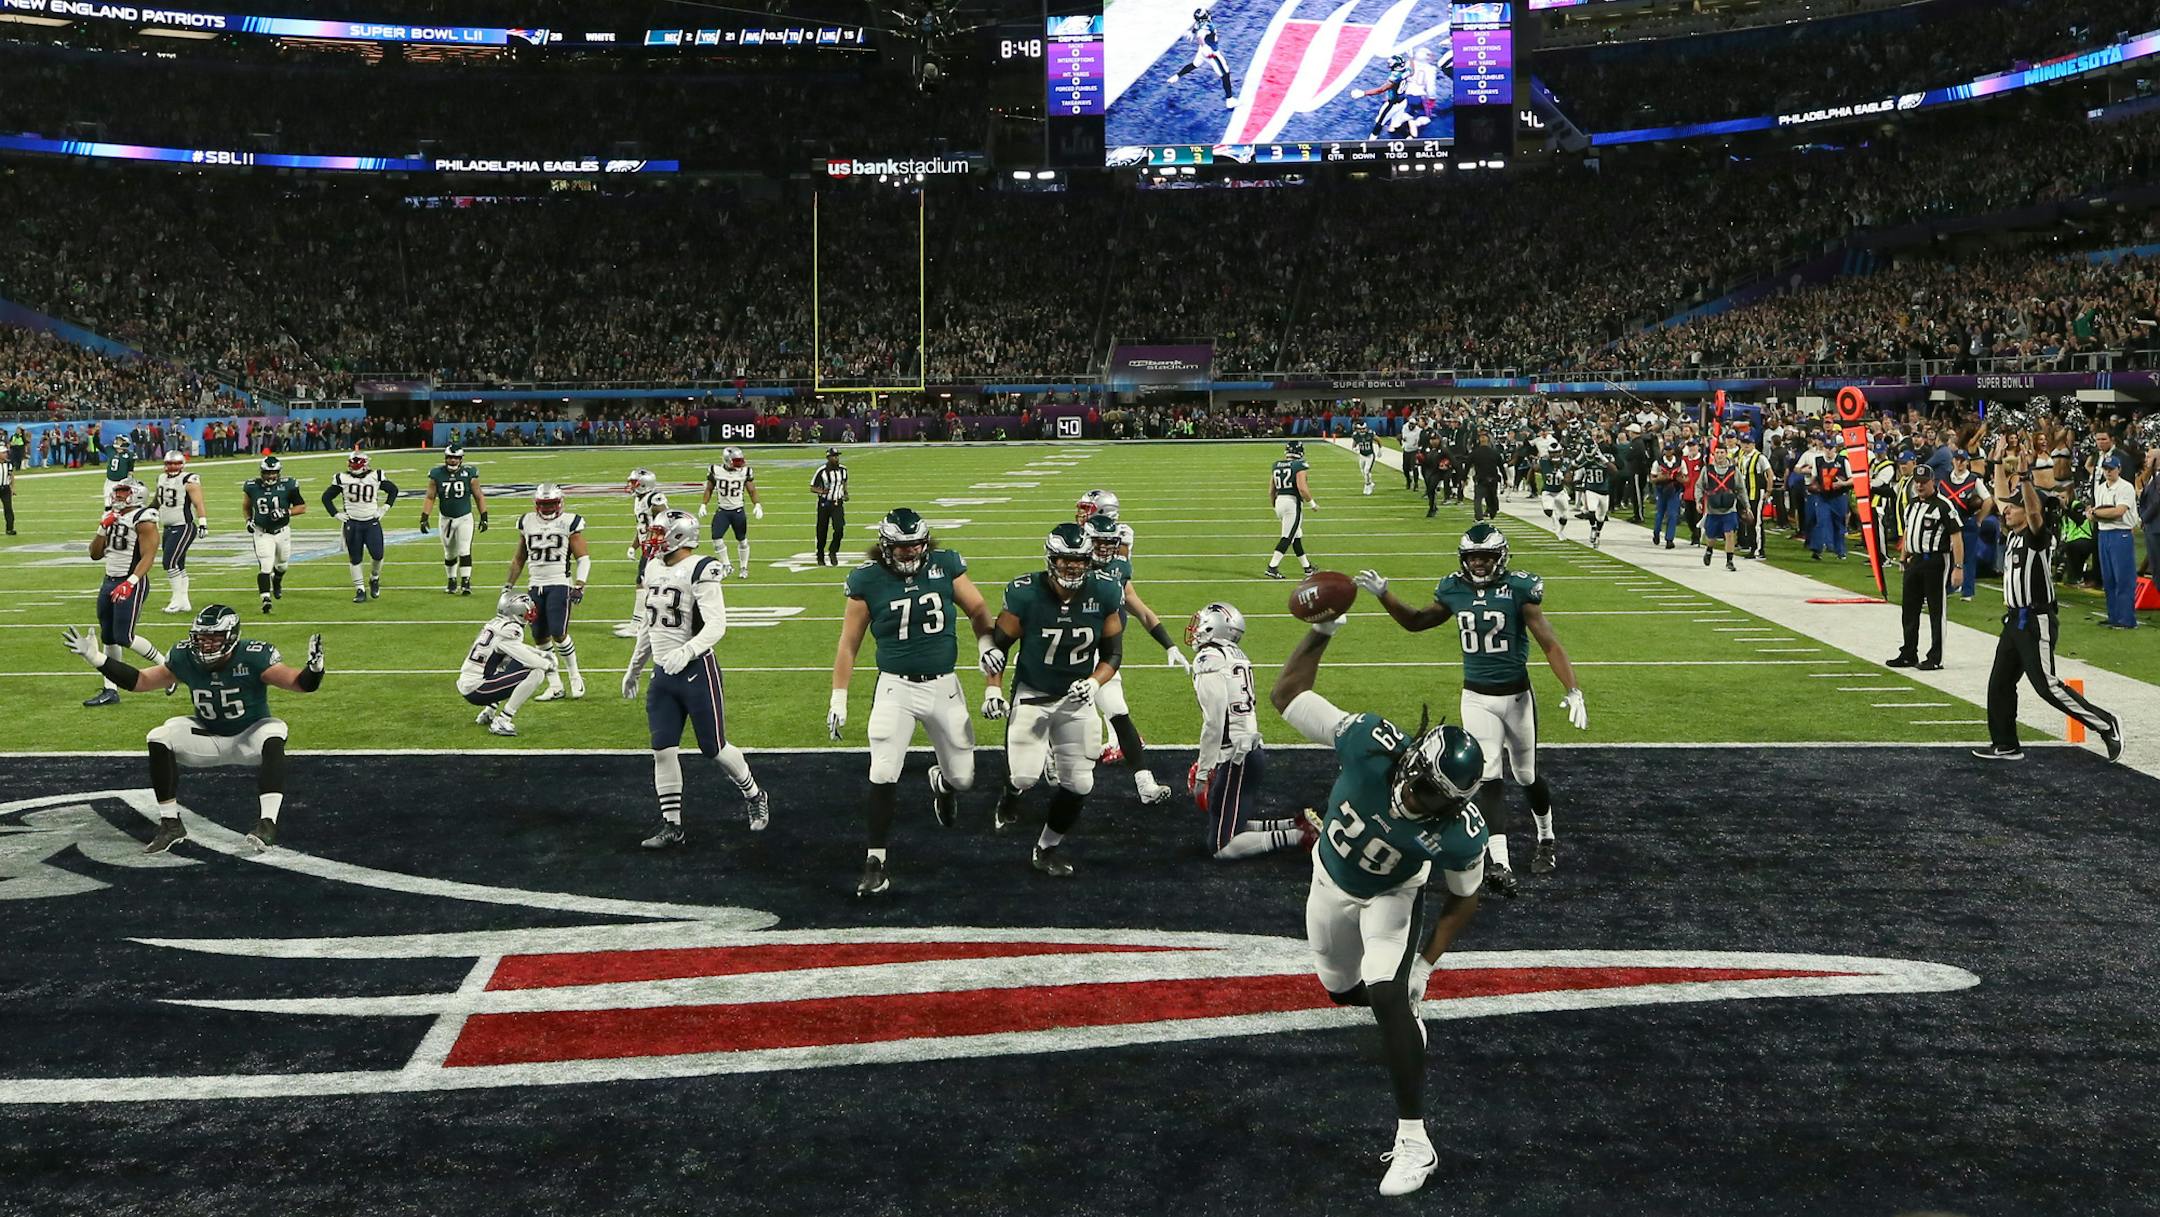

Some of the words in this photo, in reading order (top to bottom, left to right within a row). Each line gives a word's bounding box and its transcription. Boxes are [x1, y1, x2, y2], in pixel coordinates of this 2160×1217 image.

[4, 0, 47, 11] NEW
[50, 1, 138, 21] ENGLAND
[142, 11, 226, 28] PATRIOTS
[350, 25, 406, 40] SUPER
[410, 27, 459, 40] BOWL
[463, 28, 484, 41] LII
[585, 33, 616, 41] WHITE
[685, 33, 693, 41] 2
[725, 32, 736, 41] 21
[765, 32, 783, 41] 10.5
[789, 32, 799, 41] TD
[843, 32, 854, 41] 15
[1477, 37, 1486, 45] 0
[1001, 39, 1040, 58] 8:48
[1071, 48, 1080, 57] 0
[1478, 52, 1486, 60] 0
[1071, 63, 1080, 71] 0
[1478, 65, 1486, 74] 0
[2024, 45, 2123, 85] MINNESOTA
[1071, 77, 1080, 86] 0
[1478, 80, 1487, 89] 0
[1071, 91, 1081, 100] 0
[1478, 95, 1487, 104] 0
[1072, 105, 1081, 114] 0
[1778, 106, 1853, 126] PHILADELPHIA
[1854, 99, 1894, 116] EAGLES
[1270, 145, 1284, 160] 3
[1331, 144, 1341, 154] 2
[1360, 143, 1367, 153] 1
[1388, 142, 1404, 152] 10
[1424, 141, 1440, 152] 21
[191, 151, 254, 165] #SBLII
[1163, 148, 1176, 163] 9
[1194, 152, 1203, 164] 3
[1301, 151, 1310, 160] 3
[1328, 153, 1345, 161] QTR
[1352, 153, 1376, 161] DOWN
[1385, 152, 1396, 160] TO
[1415, 151, 1434, 160] BALL
[1436, 151, 1448, 159] ON
[435, 159, 541, 172] PHILADELPHIA
[543, 160, 600, 172] EAGLES
[1977, 376, 2000, 388] SUPER
[2001, 376, 2023, 388] BOWL
[722, 423, 755, 438] 8:48
[1060, 420, 1079, 435] 40
[111, 458, 119, 471] 9
[1274, 468, 1293, 489] 62
[349, 483, 374, 503] 90
[442, 481, 465, 498] 79
[719, 479, 741, 497] 92
[257, 496, 280, 514] 61
[528, 533, 562, 562] 52
[645, 585, 682, 627] 53
[890, 592, 944, 640] 73
[1458, 611, 1509, 653] 82
[1042, 627, 1094, 665] 72
[192, 688, 245, 719] 65
[1461, 801, 1486, 838] 29
[1327, 800, 1402, 875] 29
